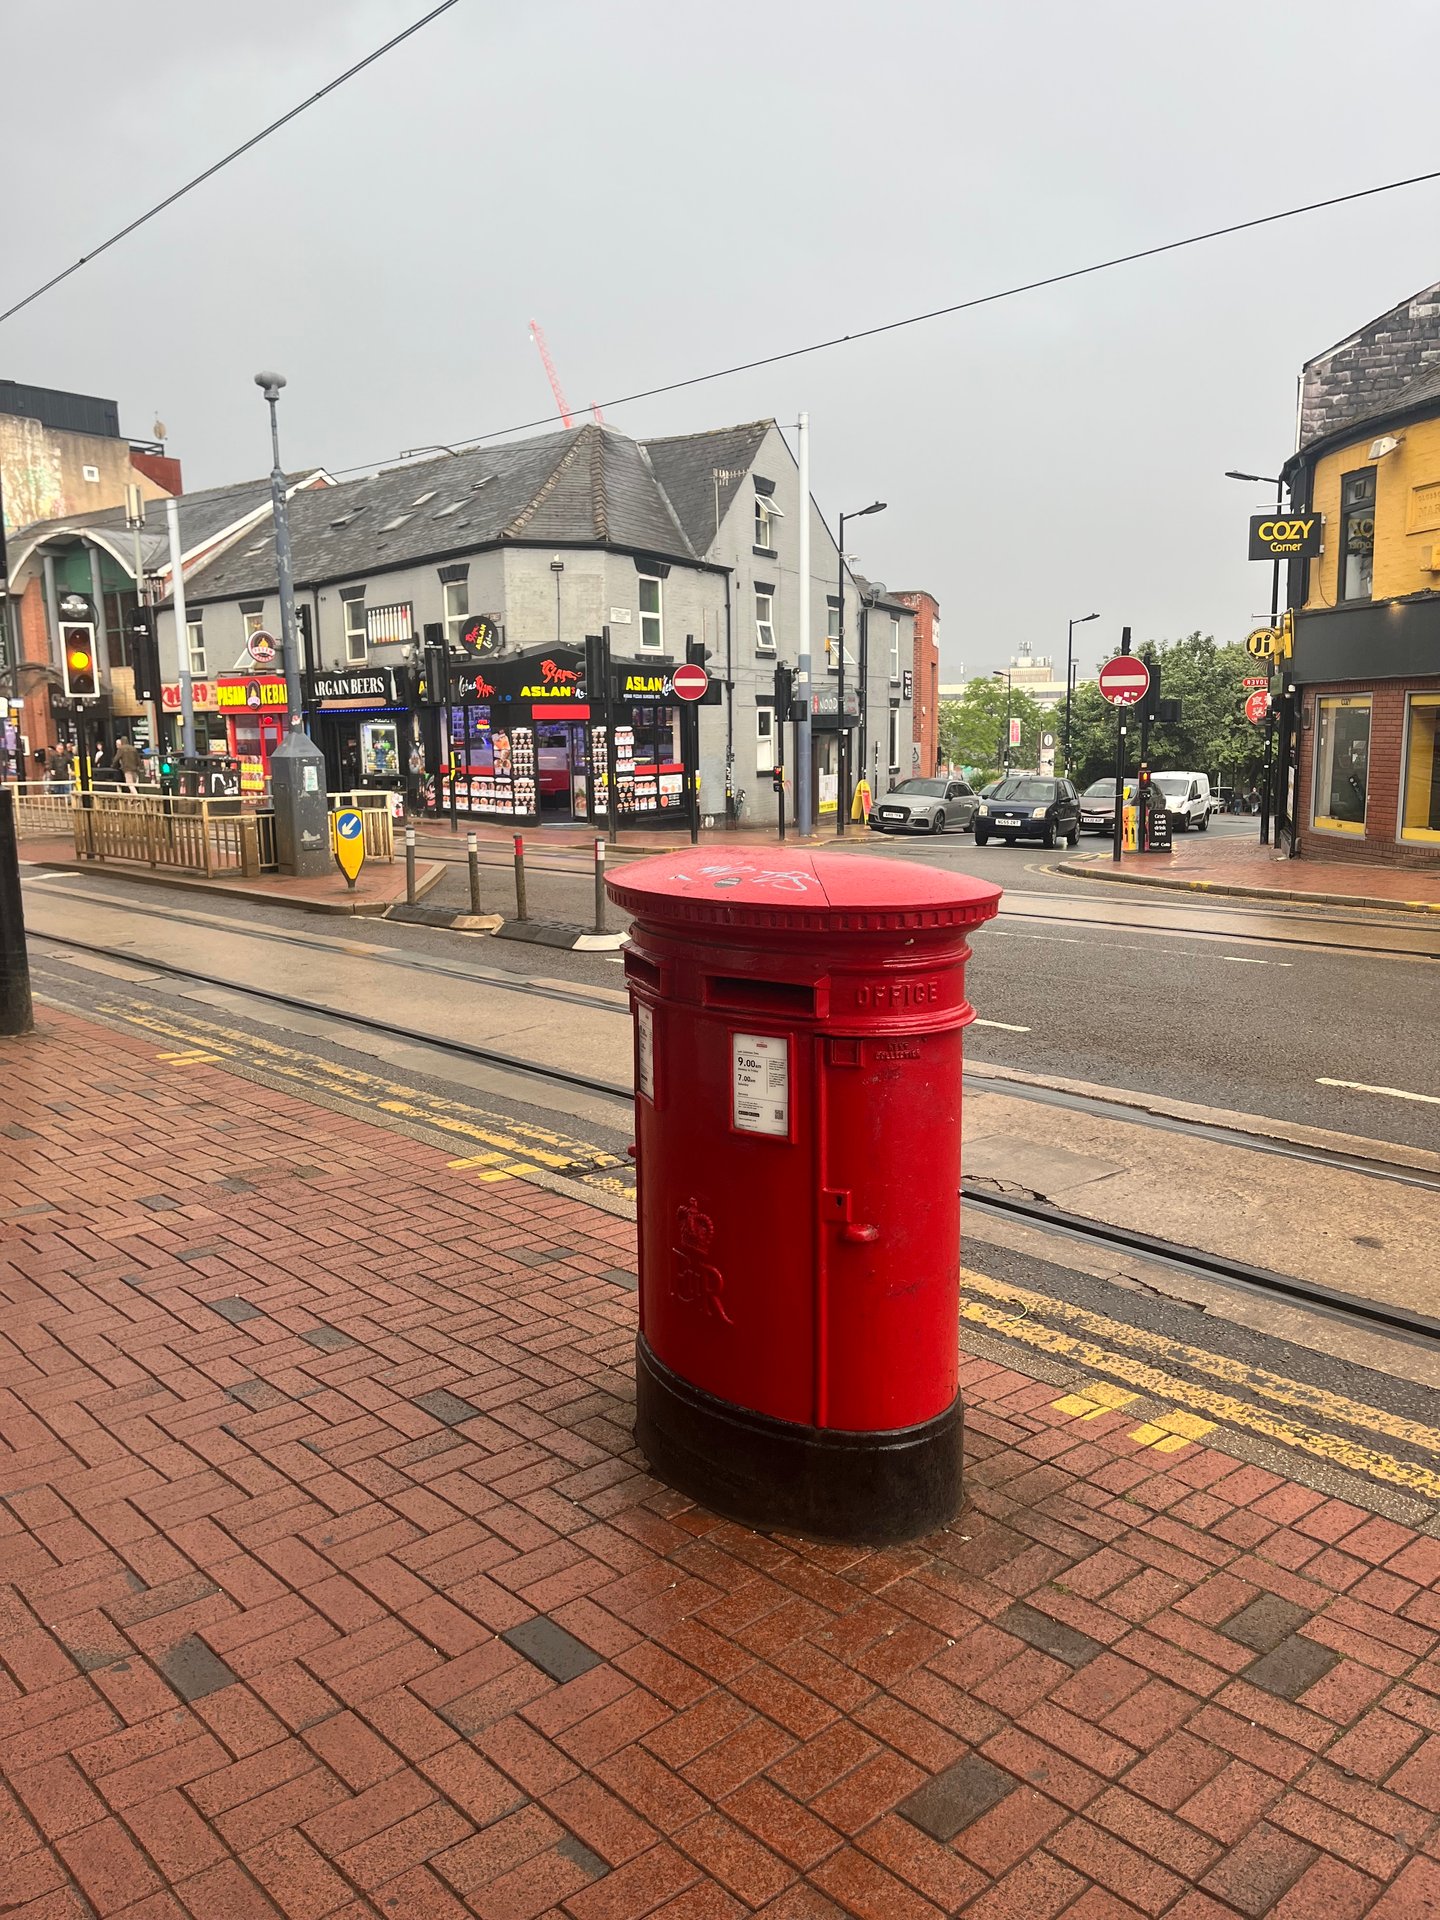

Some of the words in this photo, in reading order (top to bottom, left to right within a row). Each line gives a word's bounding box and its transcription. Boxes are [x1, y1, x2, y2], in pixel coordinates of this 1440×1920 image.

[1258, 520, 1315, 541] COZY
[1270, 542, 1302, 552] Corner
[475, 624, 487, 650] ASLAN
[315, 679, 349, 696] ARGAIN
[350, 676, 385, 695] BEERS
[854, 981, 938, 1009] OFFICE
